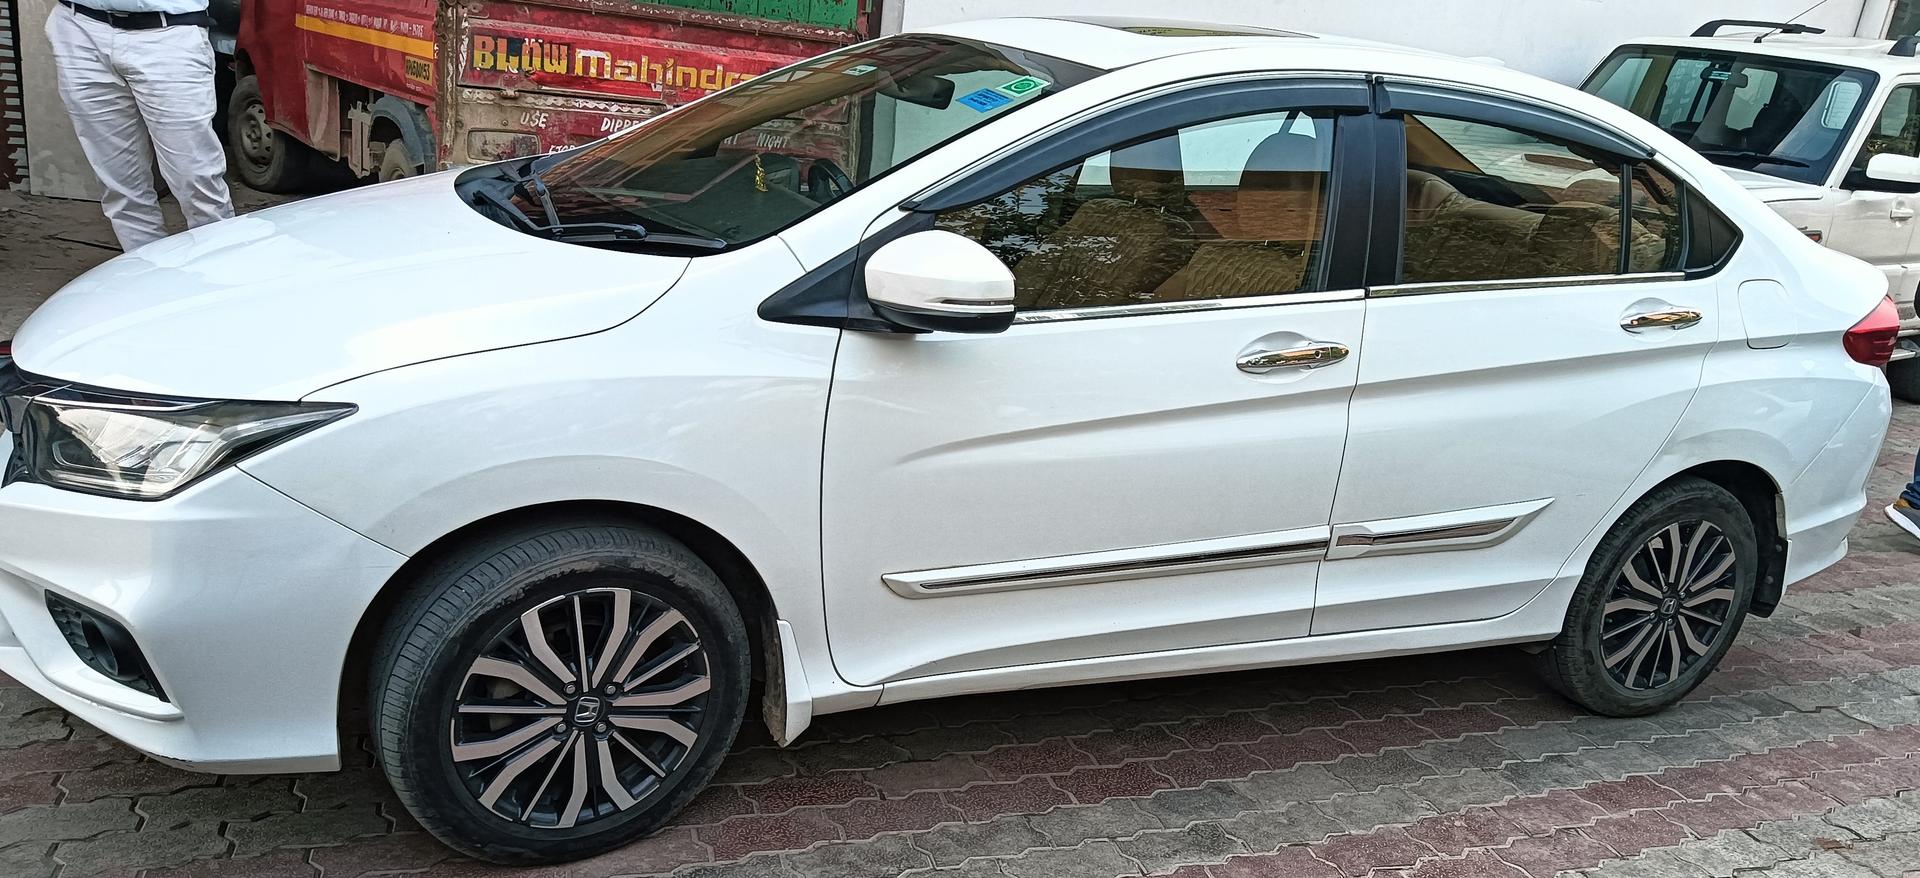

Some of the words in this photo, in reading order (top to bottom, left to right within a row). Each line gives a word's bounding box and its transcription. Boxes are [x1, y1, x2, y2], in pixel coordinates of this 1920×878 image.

[473, 35, 568, 74] BLOW
[575, 47, 757, 91] Mahindr
[520, 110, 549, 129] USE
[601, 117, 641, 132] DIPP
[756, 132, 791, 150] NIGHT
